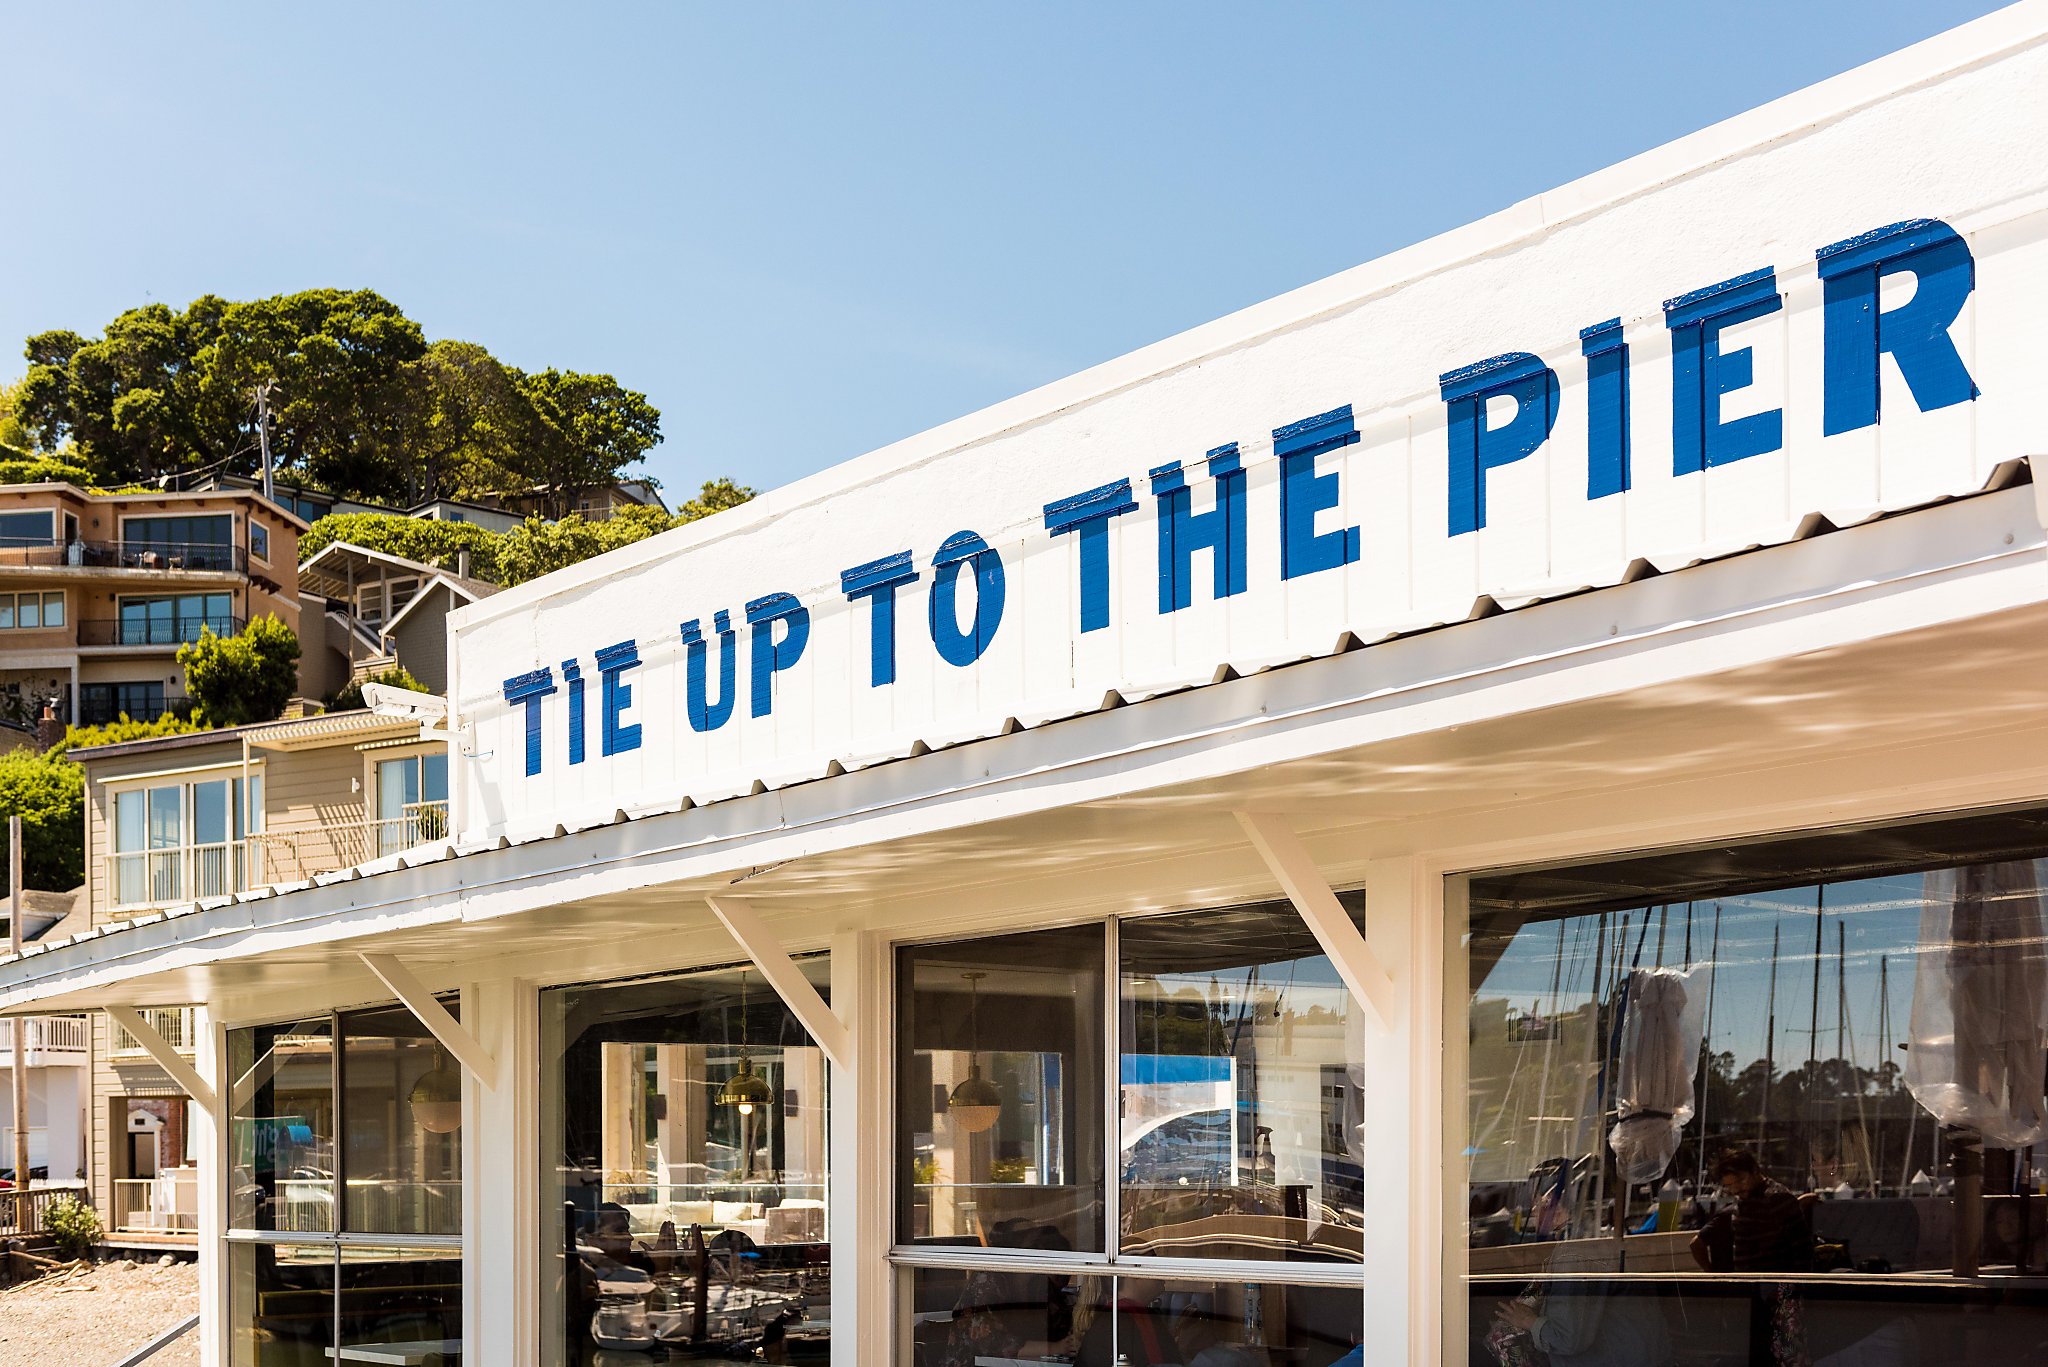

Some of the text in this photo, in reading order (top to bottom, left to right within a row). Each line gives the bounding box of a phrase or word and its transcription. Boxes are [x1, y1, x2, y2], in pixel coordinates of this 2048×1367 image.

[503, 218, 1981, 778] TIE UP TO THE PIER
